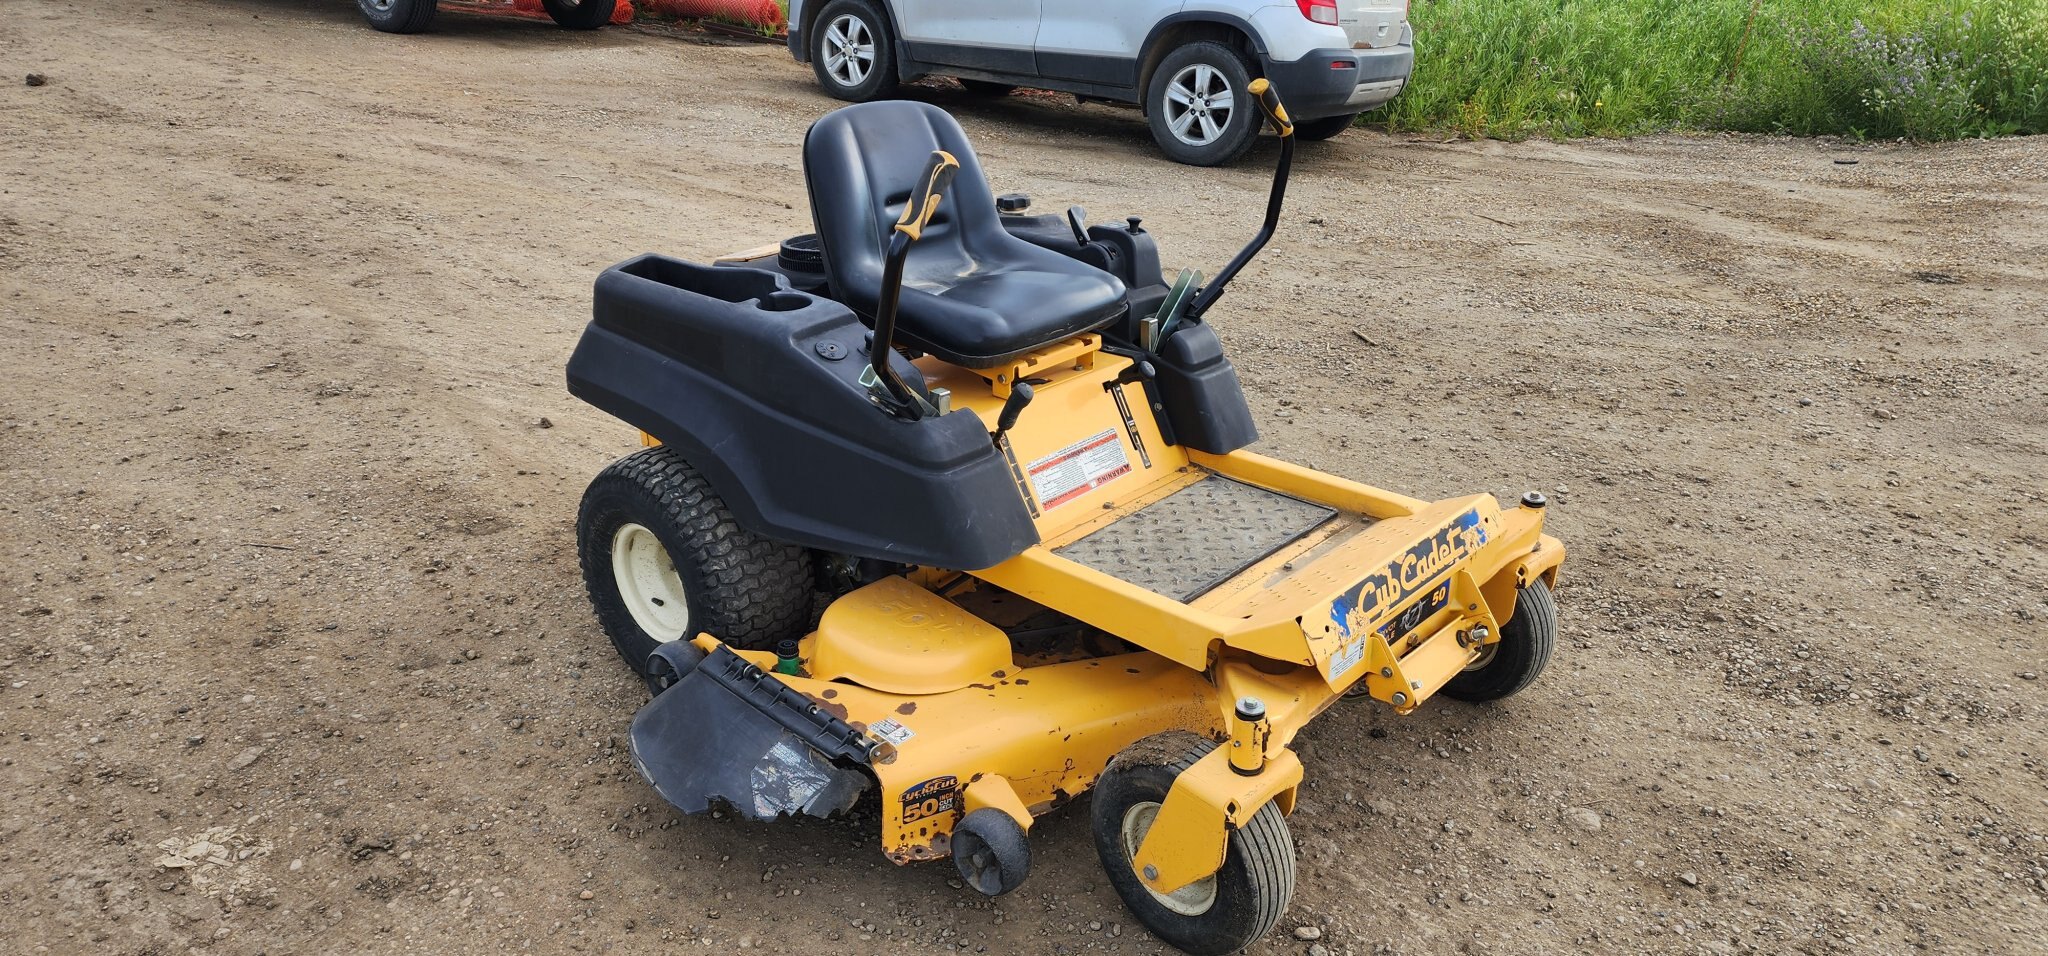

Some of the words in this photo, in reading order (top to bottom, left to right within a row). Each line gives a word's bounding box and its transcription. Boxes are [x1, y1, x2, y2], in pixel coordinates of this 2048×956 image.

[1098, 466, 1125, 483] WARNING
[1358, 565, 1401, 619] Cub
[1401, 527, 1466, 591] Cadet
[1431, 586, 1446, 607] 50
[939, 791, 954, 800] INCH
[939, 797, 953, 806] CUT
[903, 798, 939, 823] 50
